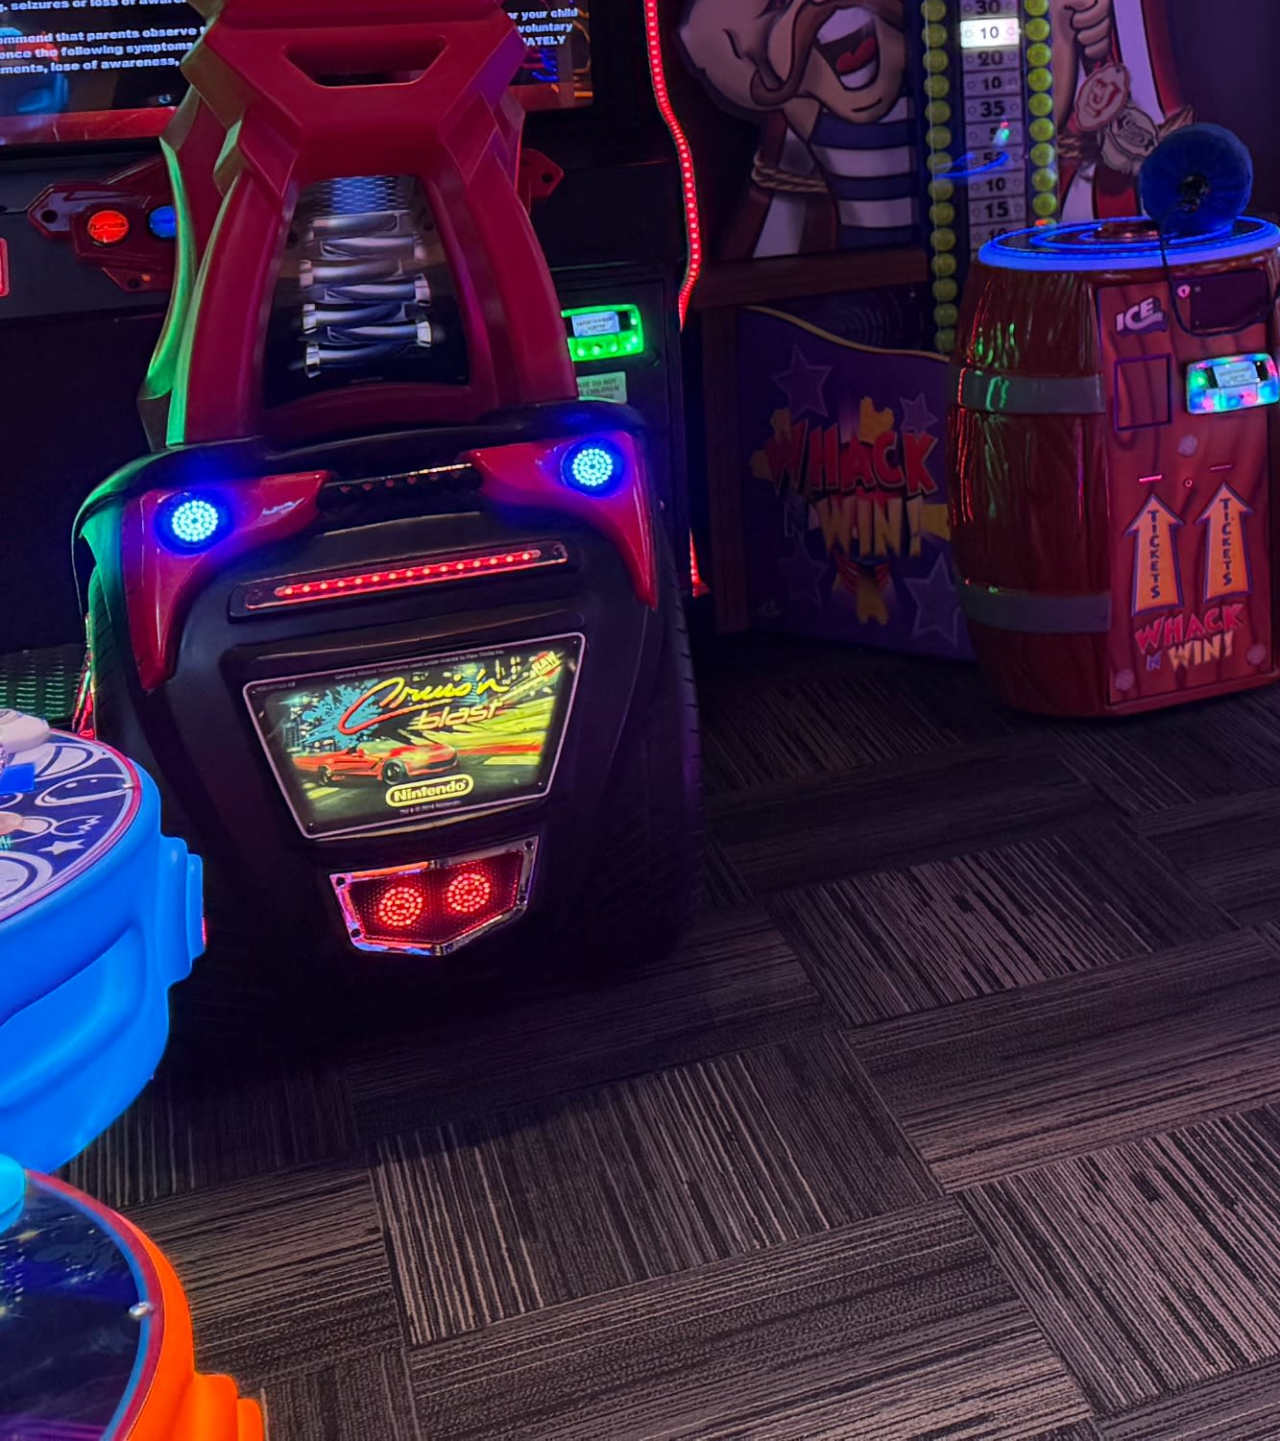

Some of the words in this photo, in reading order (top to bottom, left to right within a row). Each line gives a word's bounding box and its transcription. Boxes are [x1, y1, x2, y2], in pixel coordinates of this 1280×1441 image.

[11, 0, 70, 10] seizures
[56, 32, 84, 41] that
[87, 30, 140, 41] parents
[142, 27, 197, 38] observe
[521, 11, 548, 21] your
[550, 8, 578, 18] child
[980, 26, 1000, 39] 10
[61, 45, 124, 57] following
[126, 41, 193, 54] symptoms
[101, 57, 180, 71] awareness,
[977, 52, 1003, 67] 20
[982, 77, 1001, 90] 10
[986, 178, 1005, 191] 10
[986, 202, 1009, 218] 15
[1116, 298, 1163, 331] ICE
[766, 419, 938, 496] WHACK
[817, 496, 921, 557] WIN!
[1149, 511, 1160, 599] TICKETS
[1221, 499, 1232, 586] TICKETS
[1135, 604, 1243, 654] WHACK
[1168, 630, 1233, 671] WIN!
[337, 670, 509, 736] Cruis'n
[415, 700, 506, 730] blast
[394, 779, 467, 802] Nintendo
